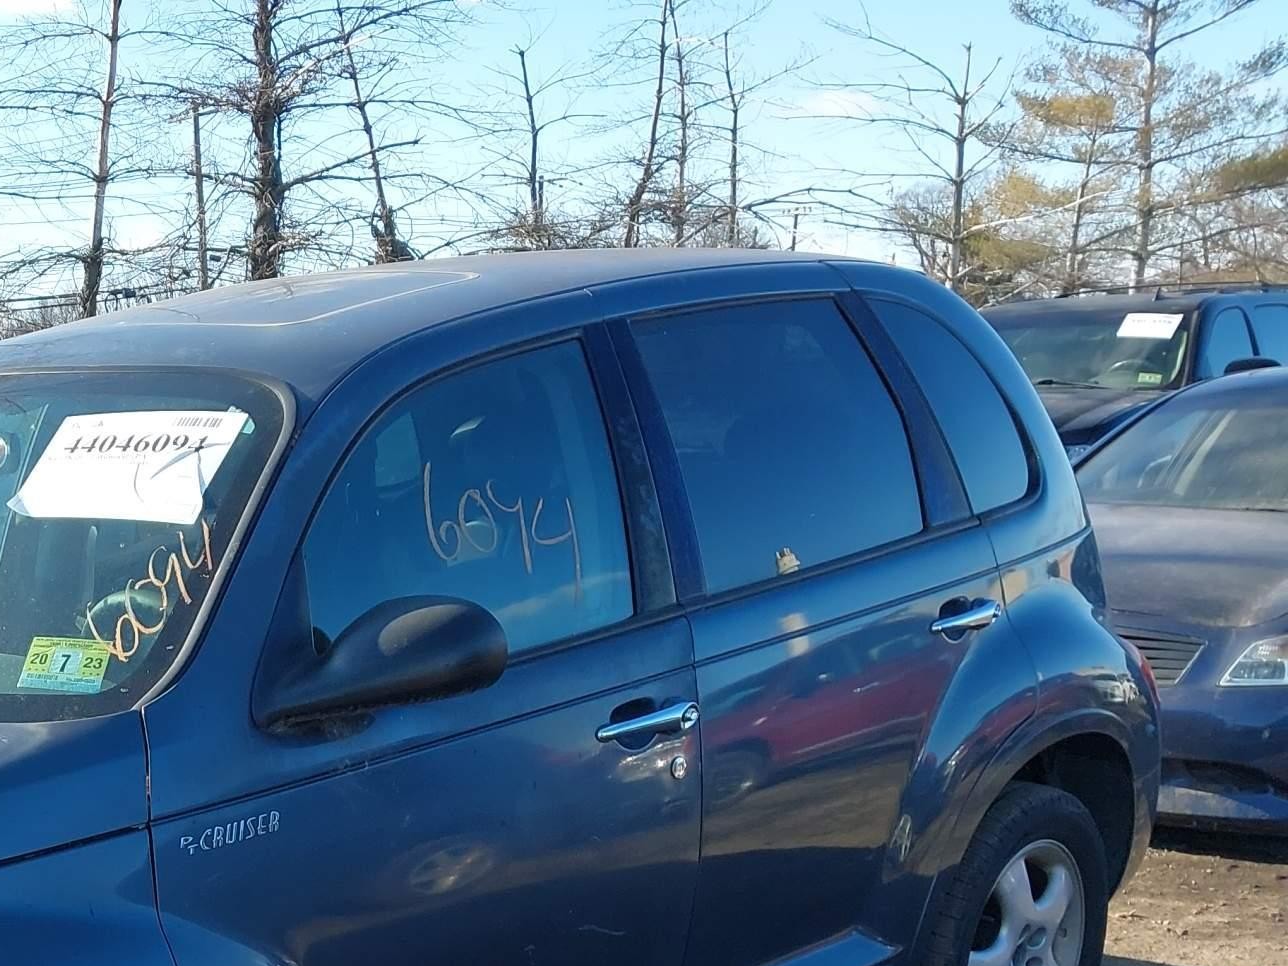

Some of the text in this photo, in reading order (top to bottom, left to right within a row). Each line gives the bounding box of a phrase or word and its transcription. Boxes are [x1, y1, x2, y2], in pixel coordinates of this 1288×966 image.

[64, 434, 209, 453] 44046094
[424, 461, 581, 604] 6094
[87, 518, 213, 662] 6094
[30, 653, 104, 673] 20 7 23
[180, 811, 280, 855] PT CRUISER
